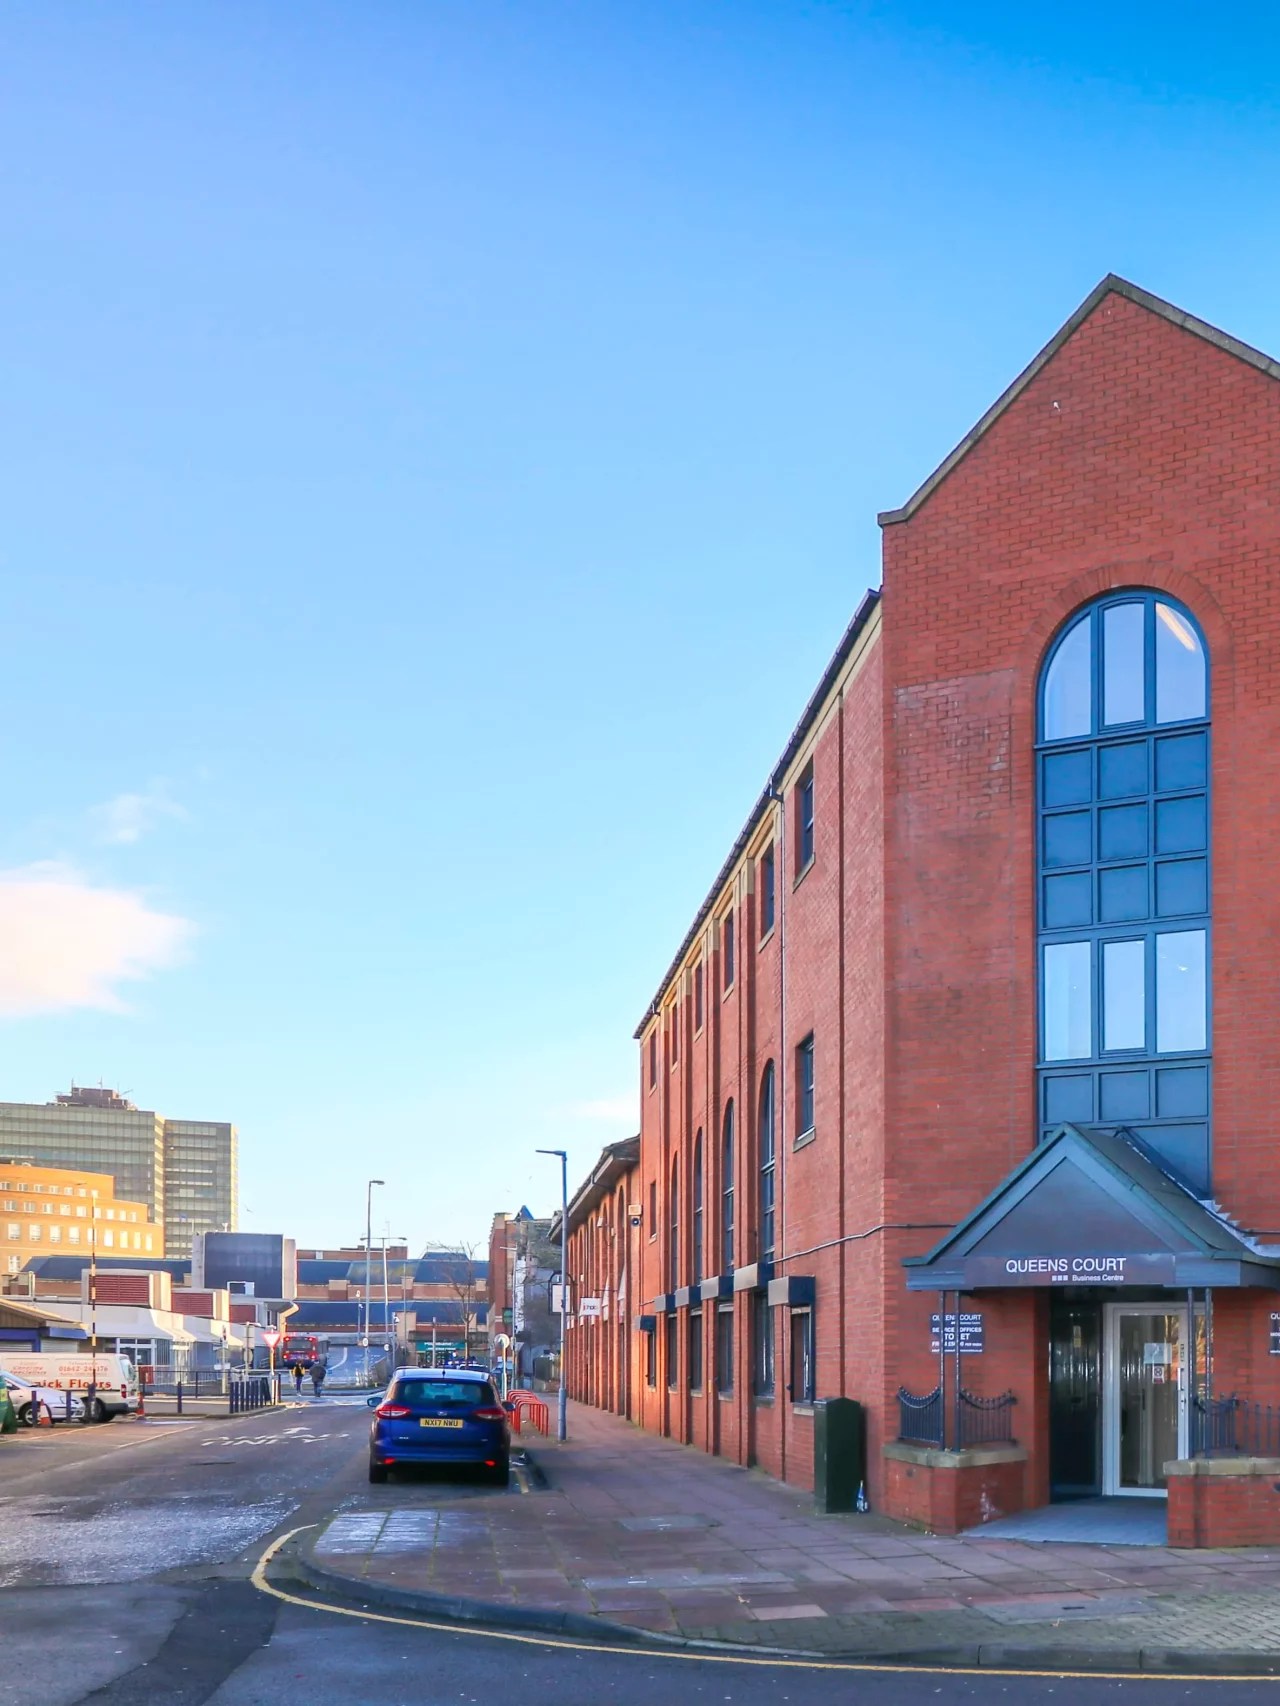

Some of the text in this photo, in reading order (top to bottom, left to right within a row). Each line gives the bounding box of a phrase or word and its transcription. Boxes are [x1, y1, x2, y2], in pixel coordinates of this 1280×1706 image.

[1005, 1257, 1127, 1273] QUEENS COURT
[1072, 1274, 1101, 1282] Business
[944, 1333, 955, 1341] TO
[69, 1379, 112, 1388] Flors
